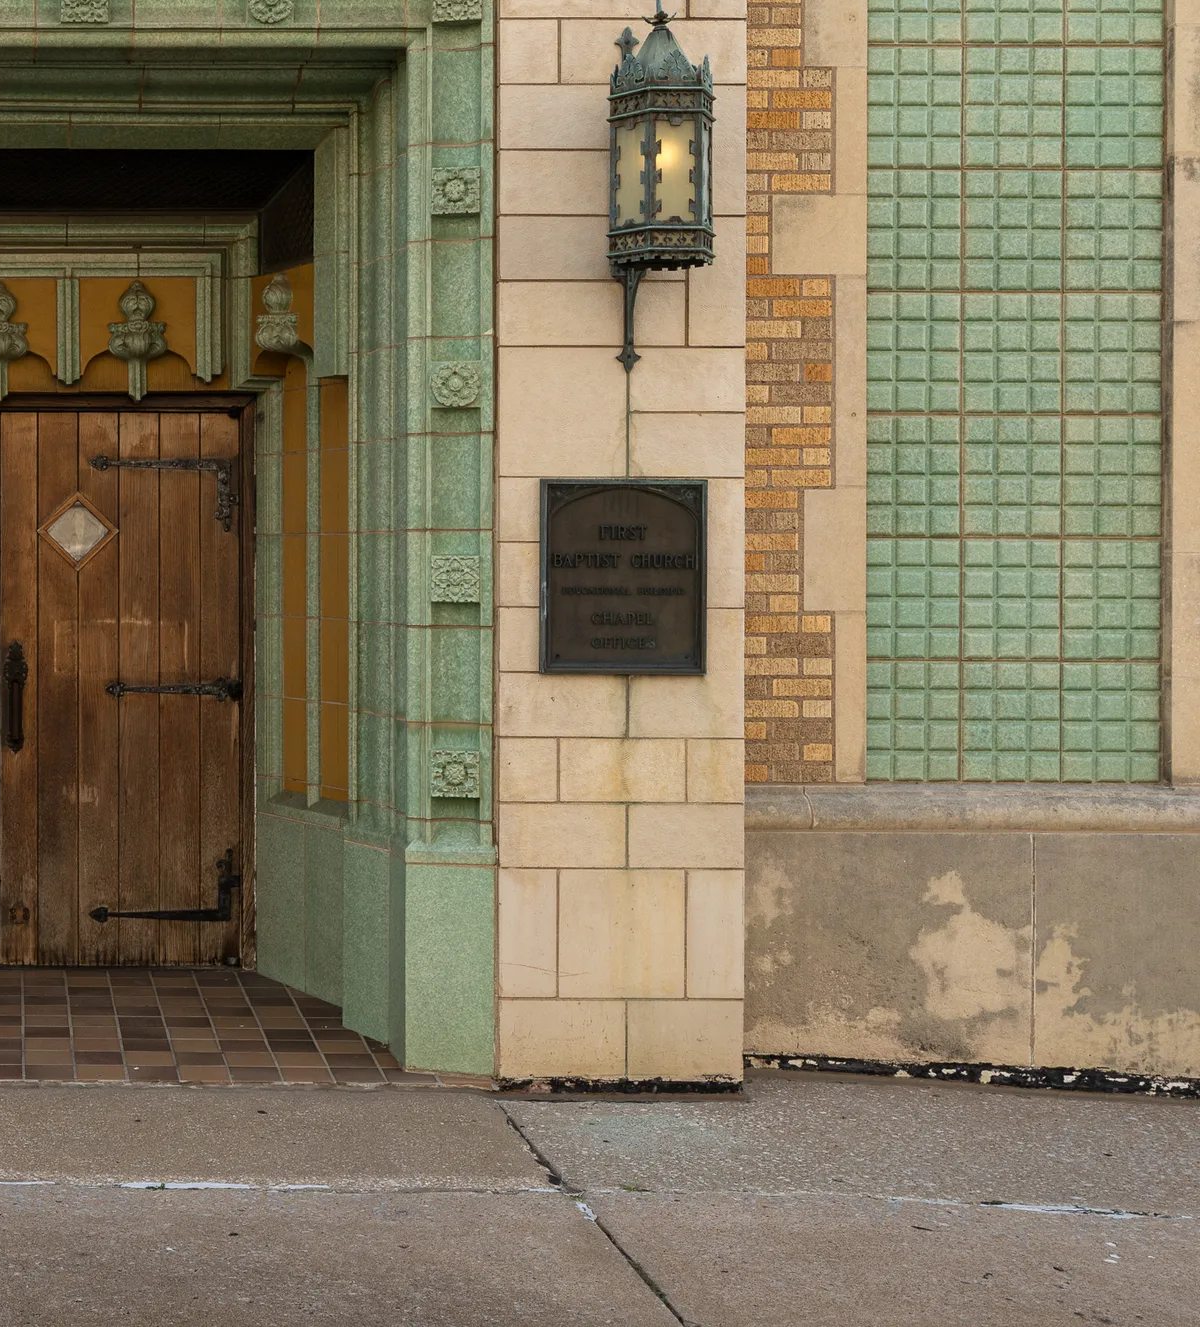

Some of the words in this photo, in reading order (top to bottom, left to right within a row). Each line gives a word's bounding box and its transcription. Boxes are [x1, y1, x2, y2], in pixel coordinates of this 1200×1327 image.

[599, 524, 647, 540] FIRST
[553, 552, 620, 568] BAPTIST
[631, 552, 696, 568] CHURCH
[637, 586, 685, 596] BUILDING
[591, 612, 653, 626] CHAPEL
[591, 637, 656, 650] OFFICES
